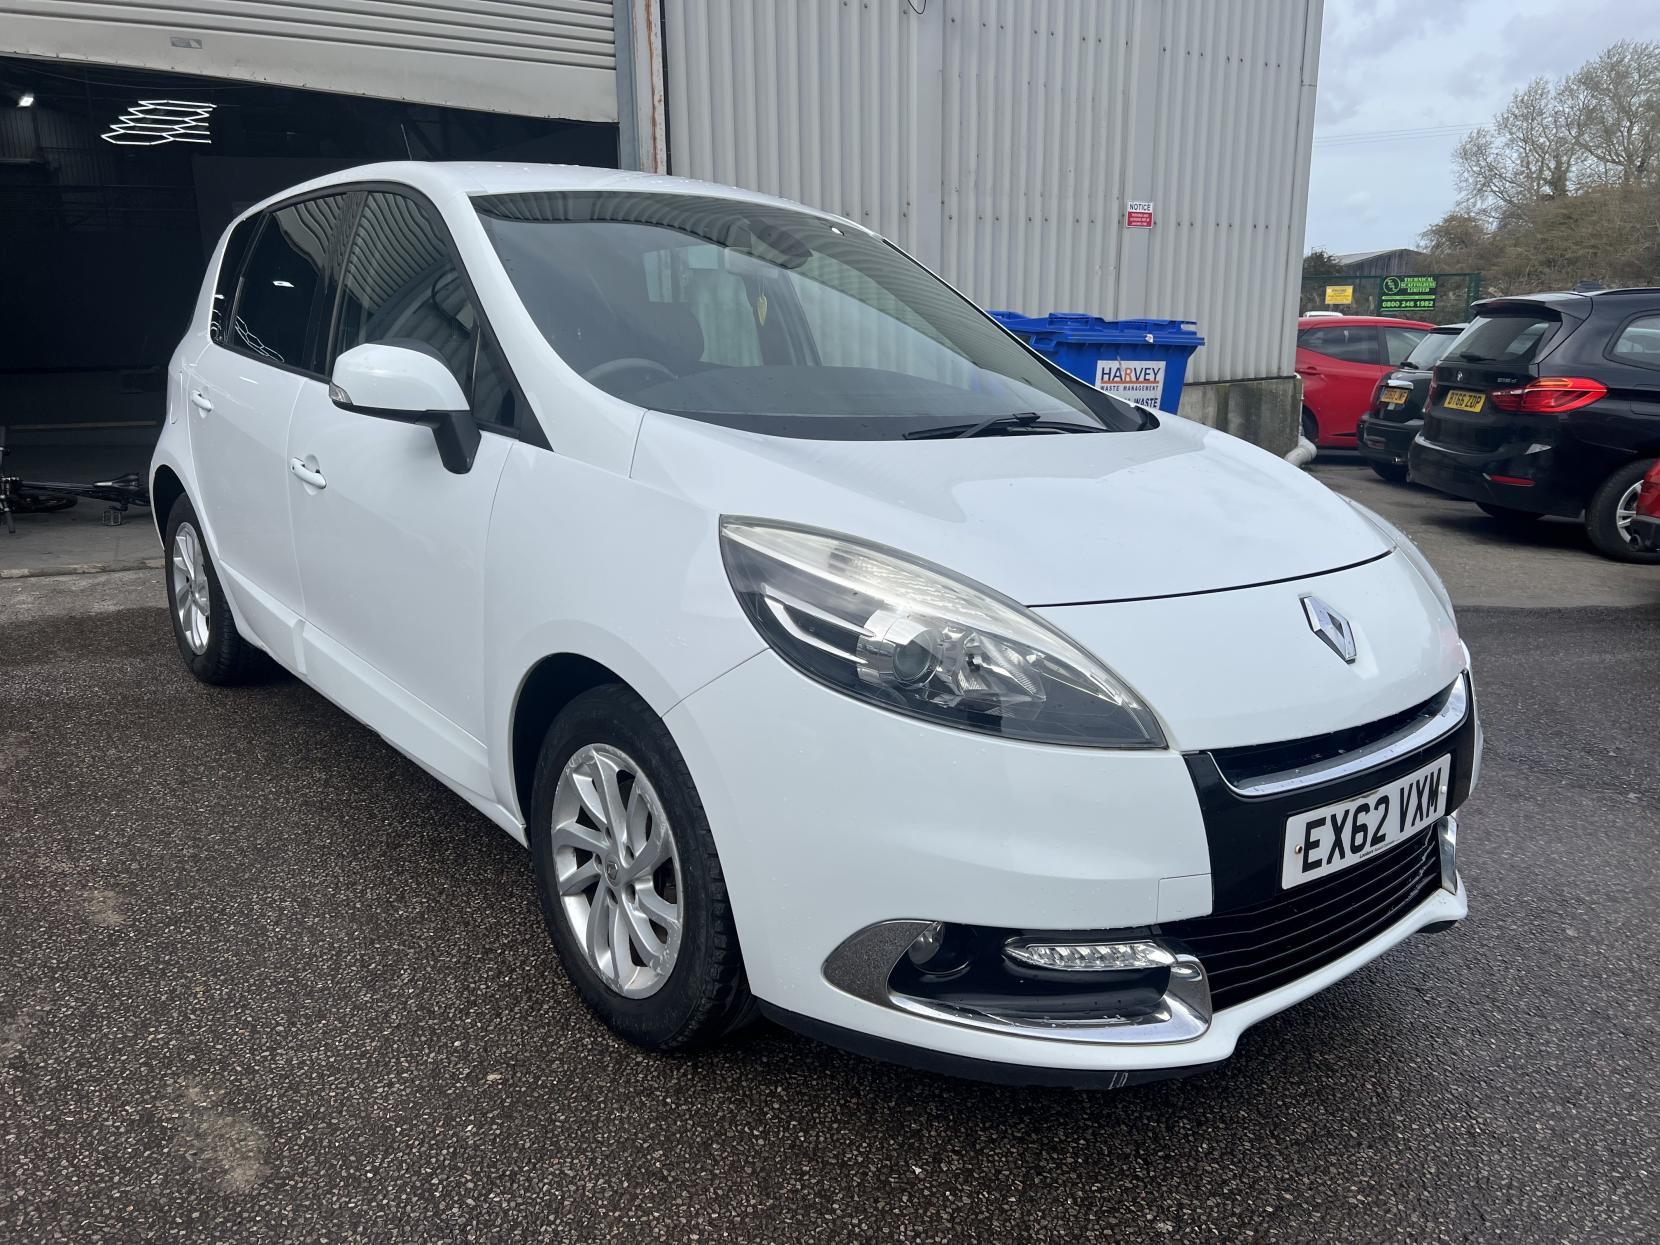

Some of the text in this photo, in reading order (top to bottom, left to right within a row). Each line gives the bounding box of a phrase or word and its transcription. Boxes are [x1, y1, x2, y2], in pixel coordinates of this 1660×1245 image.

[1129, 203, 1151, 211] NOTICE
[1101, 367, 1161, 382] HARVEY
[1133, 398, 1159, 408] WASTE
[1447, 392, 1467, 406] BT66
[1302, 767, 1442, 874] EX62 VXM
